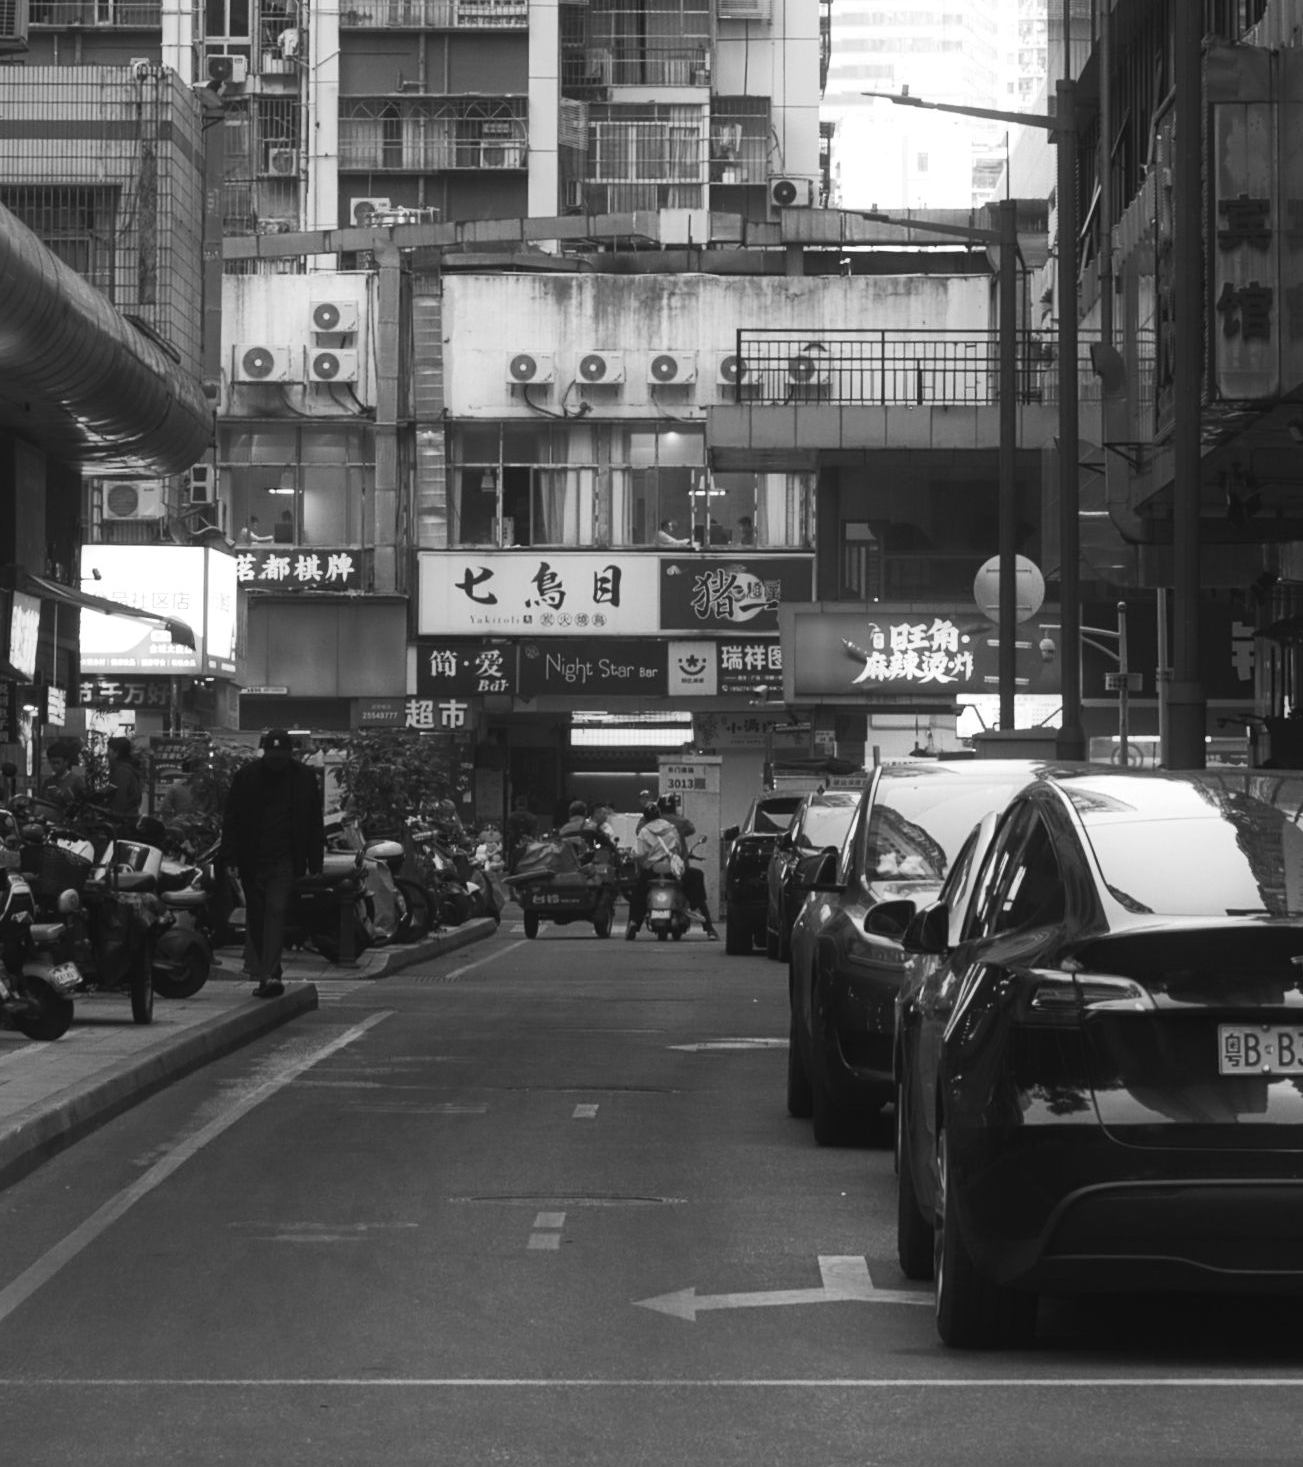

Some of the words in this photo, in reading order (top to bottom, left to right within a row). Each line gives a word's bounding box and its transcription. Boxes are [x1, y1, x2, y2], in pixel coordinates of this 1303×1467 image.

[1216, 194, 1274, 342] 宾馆
[236, 552, 356, 583] 茗都棋牌
[545, 652, 594, 685] Night
[598, 657, 636, 679] Star
[639, 665, 659, 679] Bar
[721, 645, 783, 671] 瑞祥图
[477, 679, 510, 693] Bar
[404, 698, 468, 730] 超市
[667, 778, 694, 789] 3013
